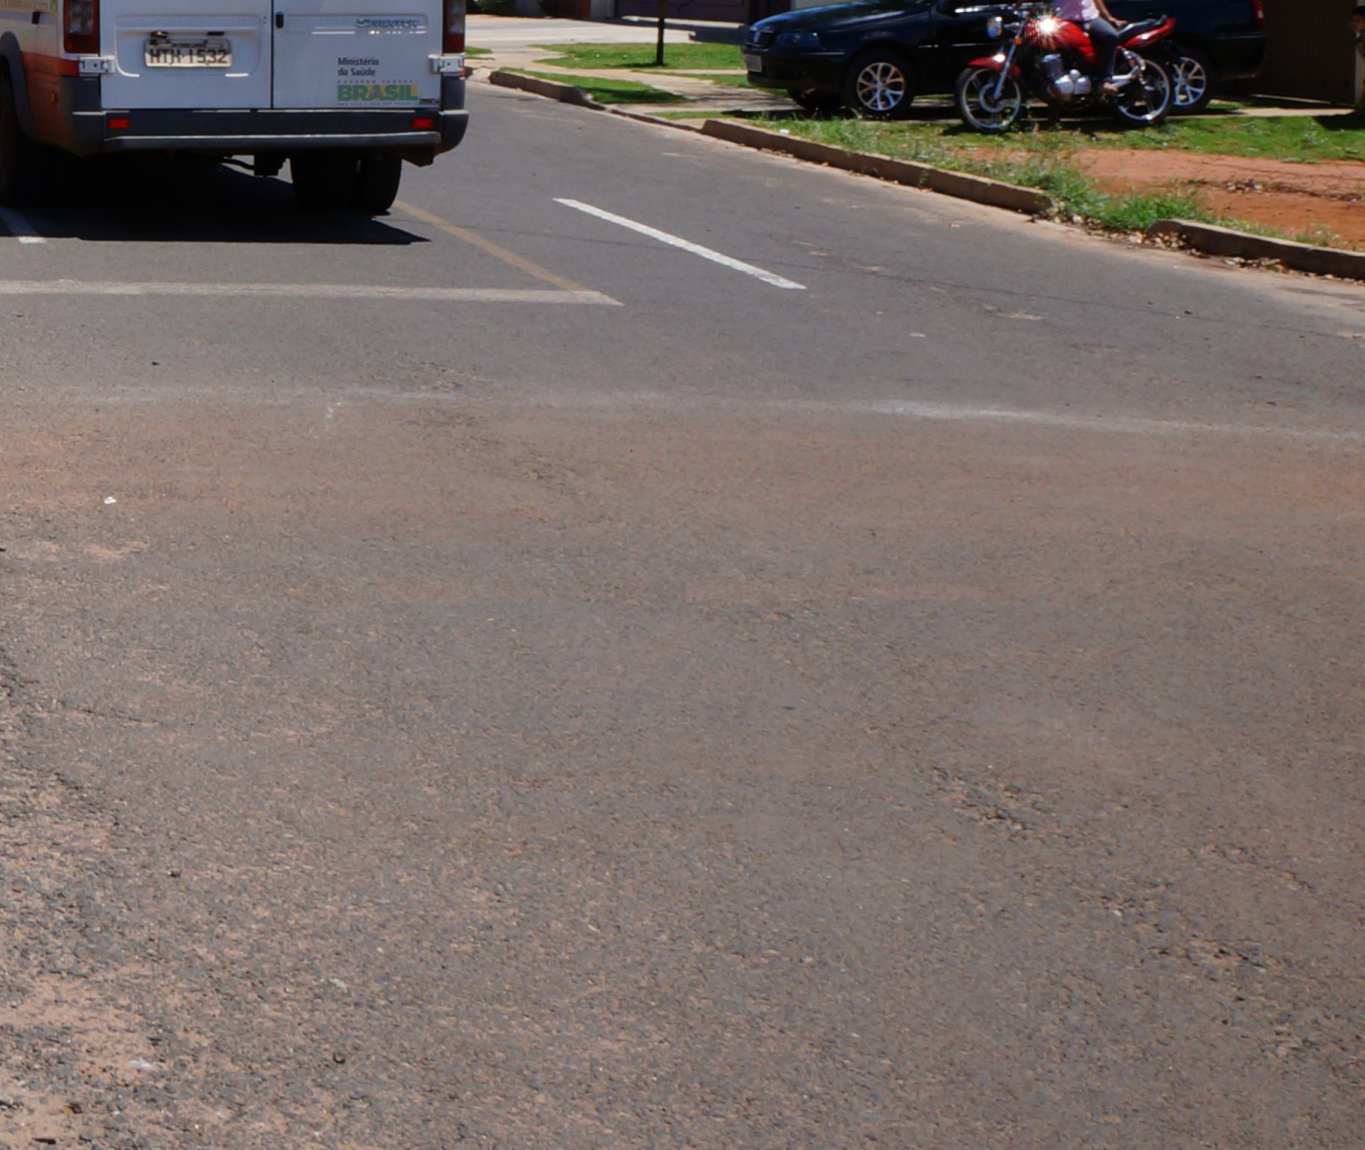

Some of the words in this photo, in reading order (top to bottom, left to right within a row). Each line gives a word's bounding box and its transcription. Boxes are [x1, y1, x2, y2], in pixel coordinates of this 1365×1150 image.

[337, 57, 379, 66] Ministério
[337, 68, 348, 76] da
[350, 67, 376, 76] Saúde
[337, 84, 418, 101] BRASIL
